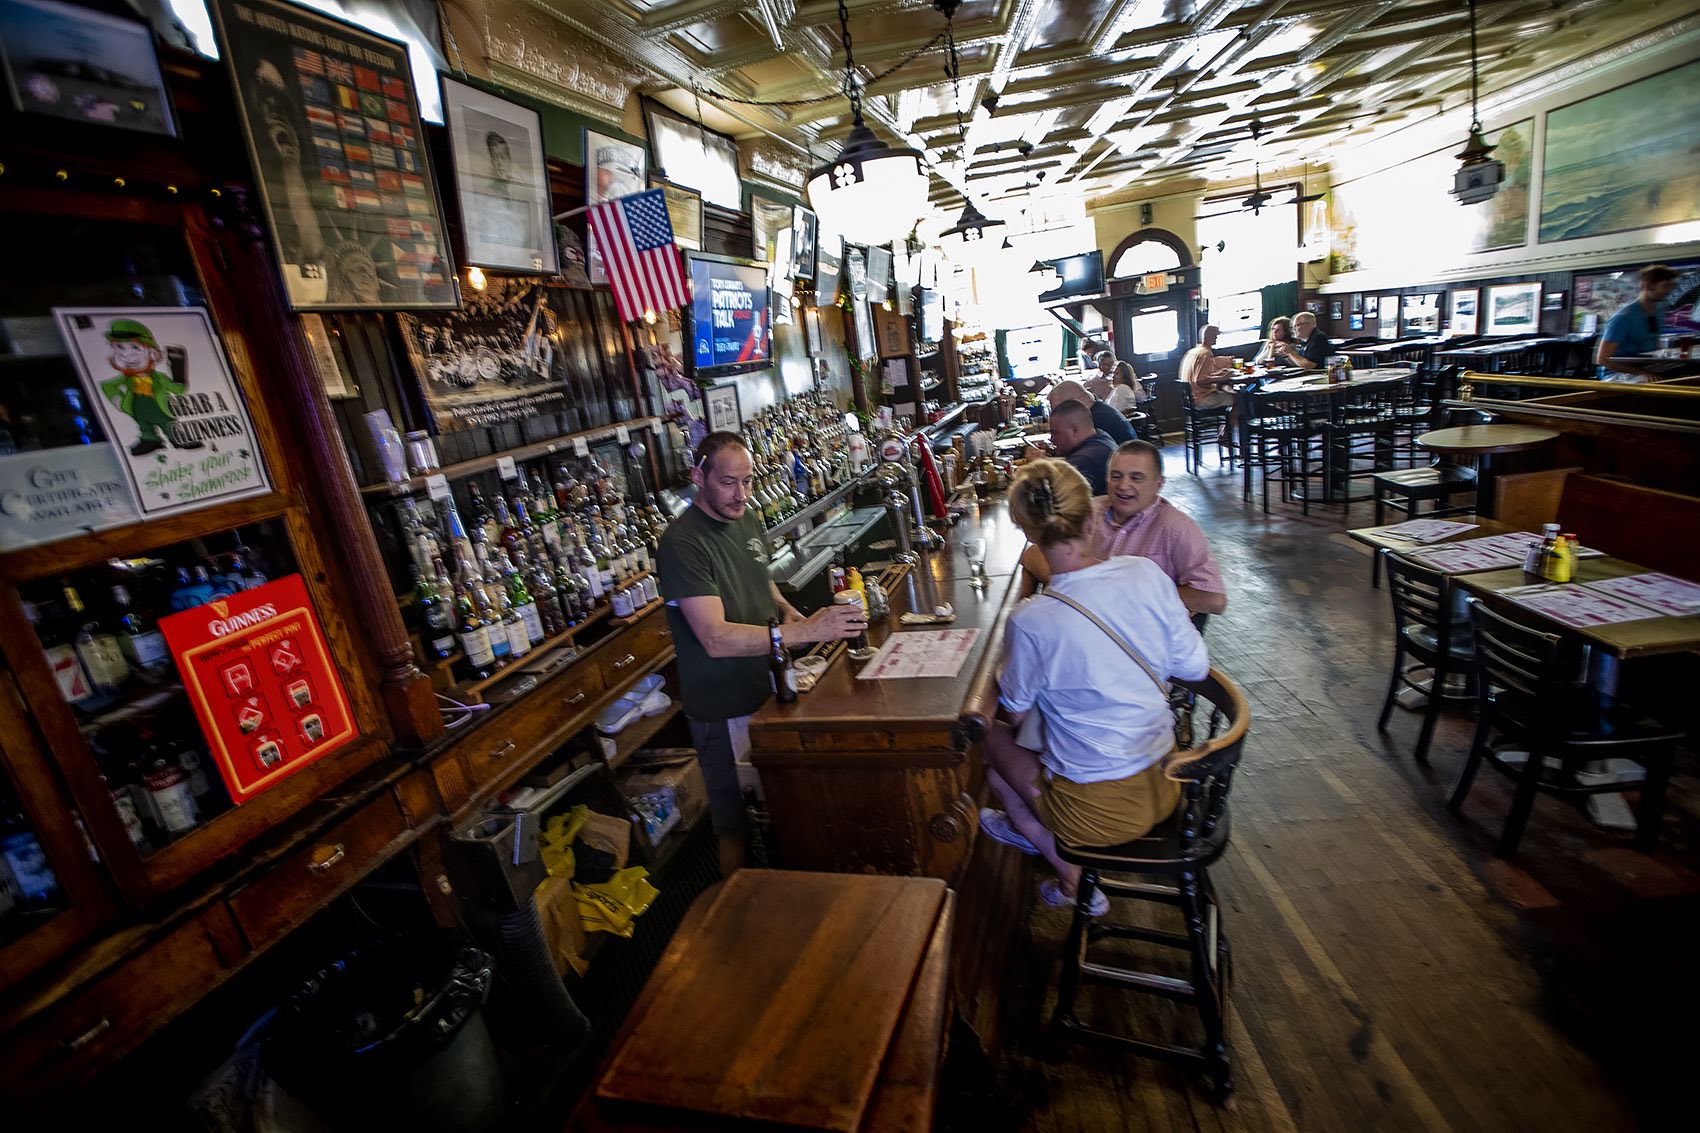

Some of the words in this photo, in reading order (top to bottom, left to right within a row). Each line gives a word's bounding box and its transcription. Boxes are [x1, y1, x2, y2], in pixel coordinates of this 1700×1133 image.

[255, 12, 289, 35] UNITED
[348, 43, 364, 60] FOR
[362, 48, 396, 71] FREEDOM
[1148, 275, 1165, 289] EXIT
[712, 290, 753, 310] PATRIOTS
[713, 309, 735, 328] TALK
[167, 392, 215, 417] GRAB
[216, 391, 230, 412] A
[171, 415, 244, 445] GUINNESS
[144, 462, 196, 488] Shake
[200, 449, 236, 476] your
[177, 465, 254, 500] Shamrock
[208, 603, 278, 638] GUINNESS
